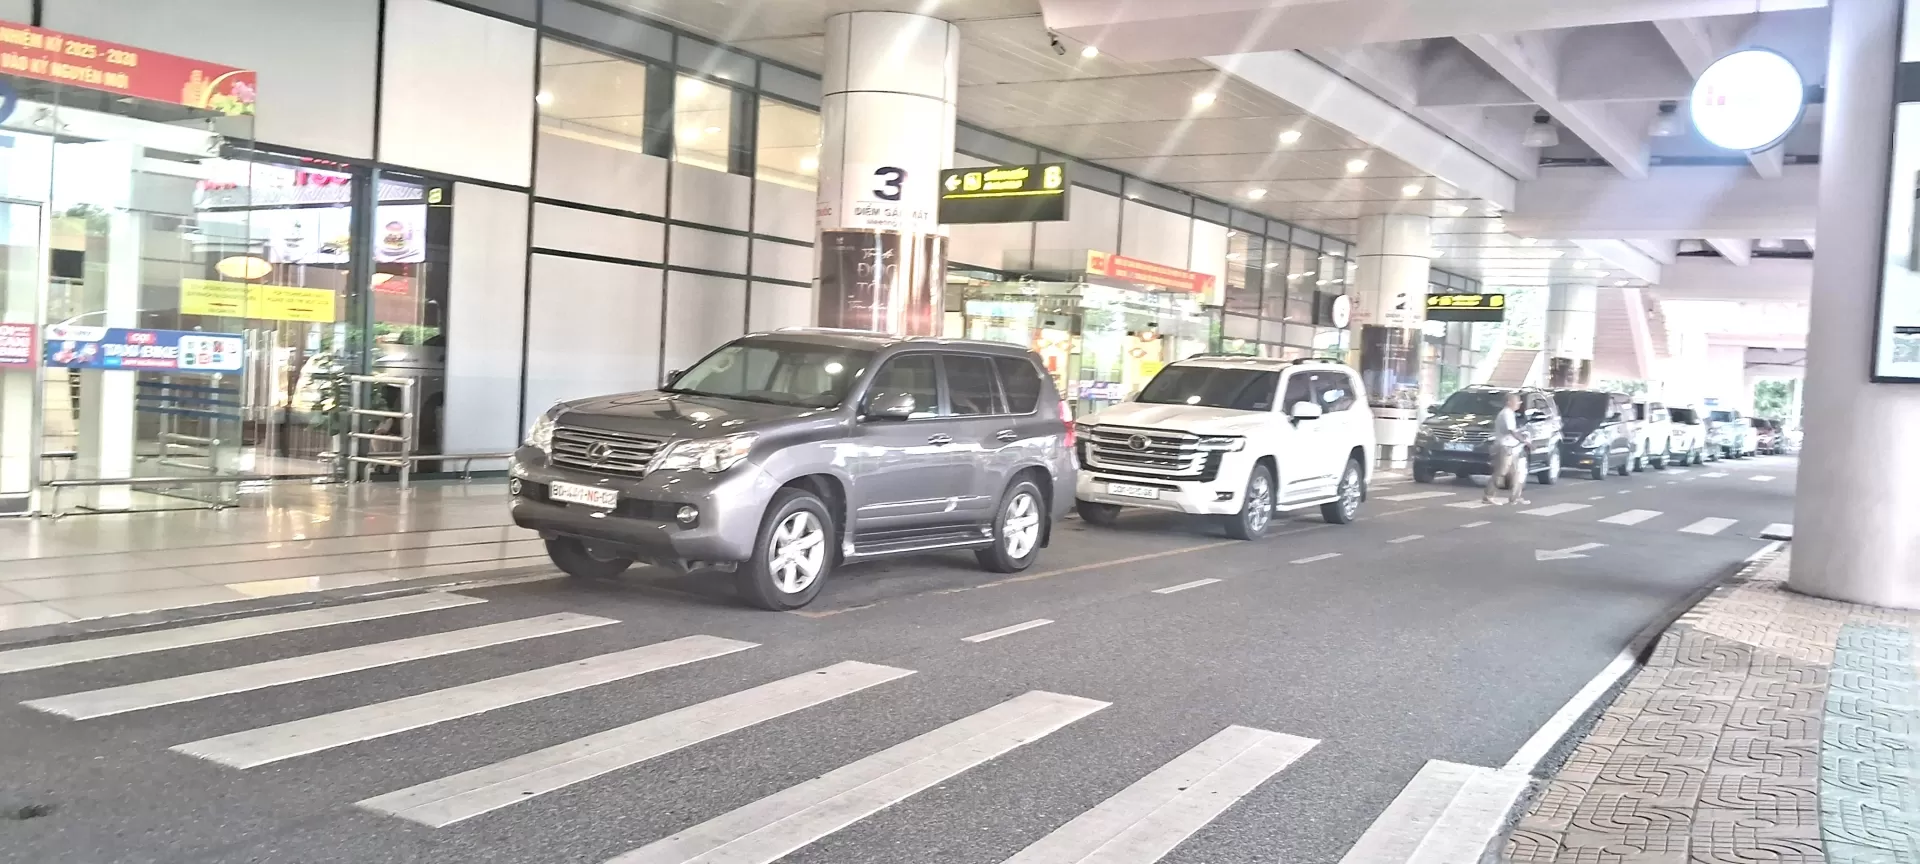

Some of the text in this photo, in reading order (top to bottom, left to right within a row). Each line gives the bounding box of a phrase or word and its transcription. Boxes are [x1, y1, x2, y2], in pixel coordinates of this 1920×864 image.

[64, 40, 97, 59] 2025
[106, 48, 137, 67] 2030
[49, 61, 103, 84] NGUYÊN
[872, 166, 908, 201] 3
[1043, 165, 1062, 189] B
